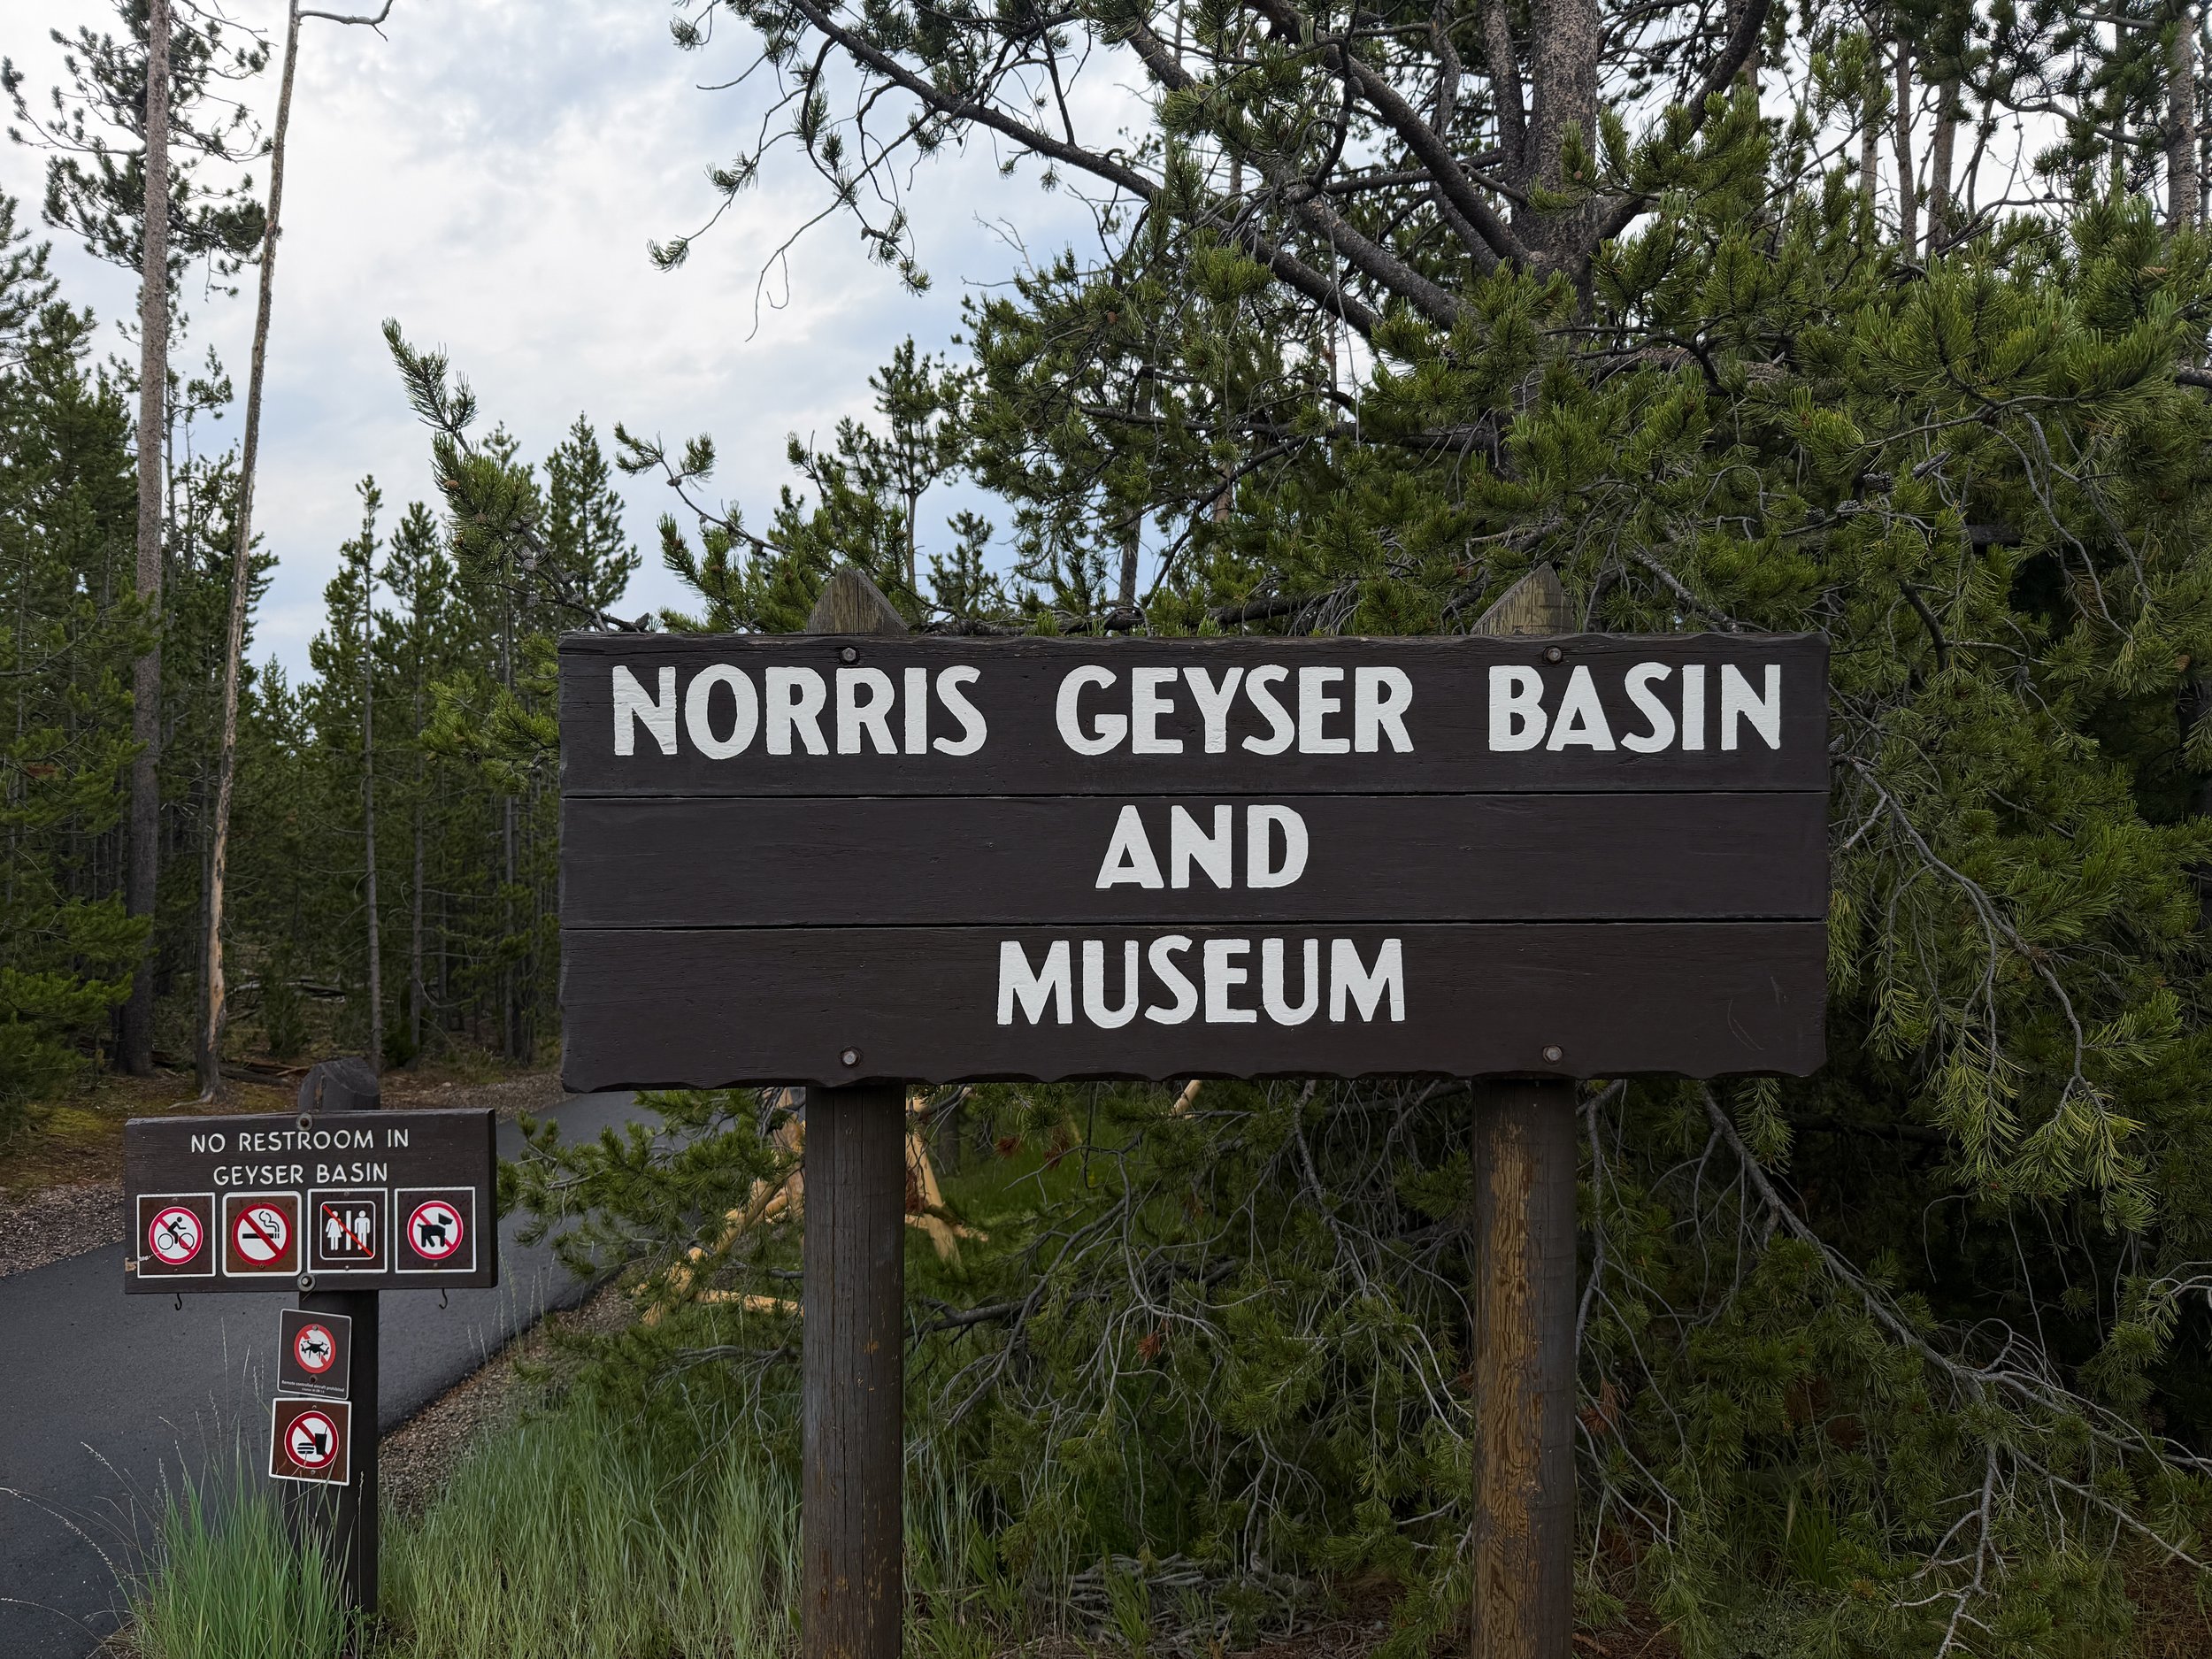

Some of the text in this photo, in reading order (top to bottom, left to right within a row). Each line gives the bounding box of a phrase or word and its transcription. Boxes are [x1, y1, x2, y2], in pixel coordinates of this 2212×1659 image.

[612, 662, 1781, 759] NORRIS GEYSER BASIN
[1094, 804, 1309, 889] AND
[996, 934, 1405, 1028] MUSEUM
[191, 1128, 409, 1154] NO RESTROOM IN
[213, 1162, 388, 1187] GEYSER BASIN
